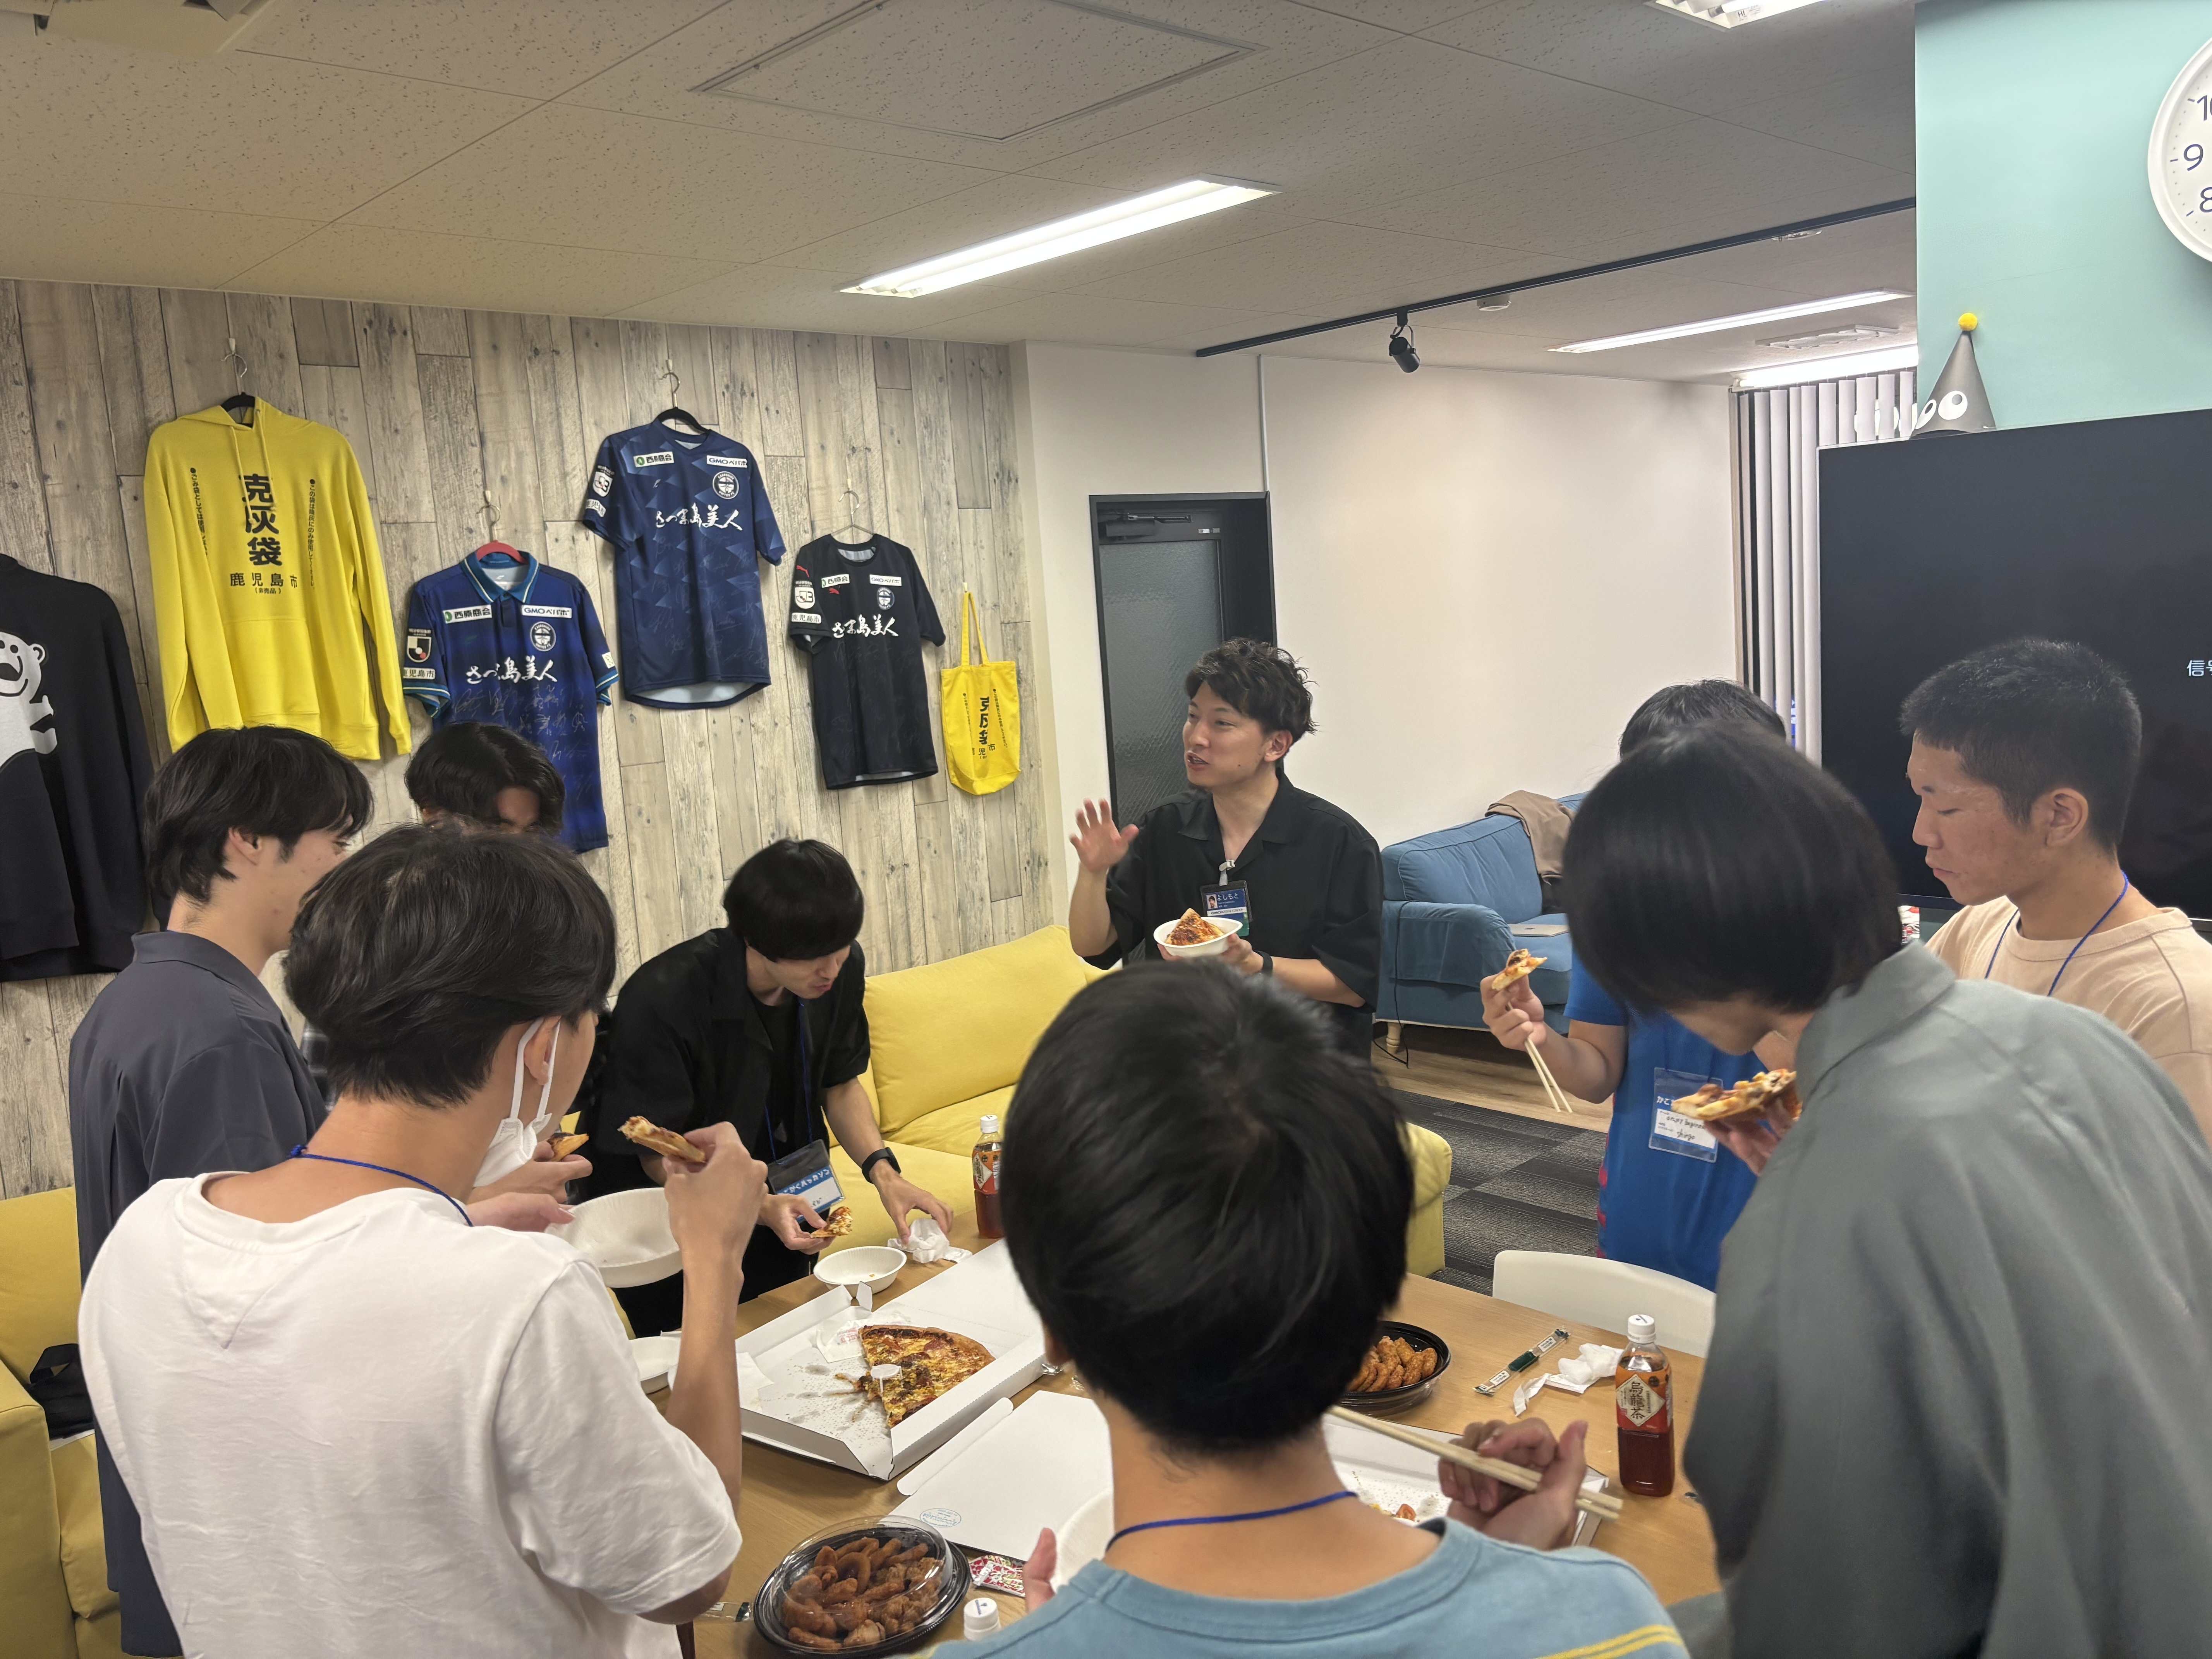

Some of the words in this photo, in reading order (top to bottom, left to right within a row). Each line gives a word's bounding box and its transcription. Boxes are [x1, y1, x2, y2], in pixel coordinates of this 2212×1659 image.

[2183, 144, 2203, 171] 9
[239, 474, 282, 566] 克灰袋
[230, 572, 297, 588] 鹿児島市
[1629, 1381, 1645, 1419] 烏龍茶
